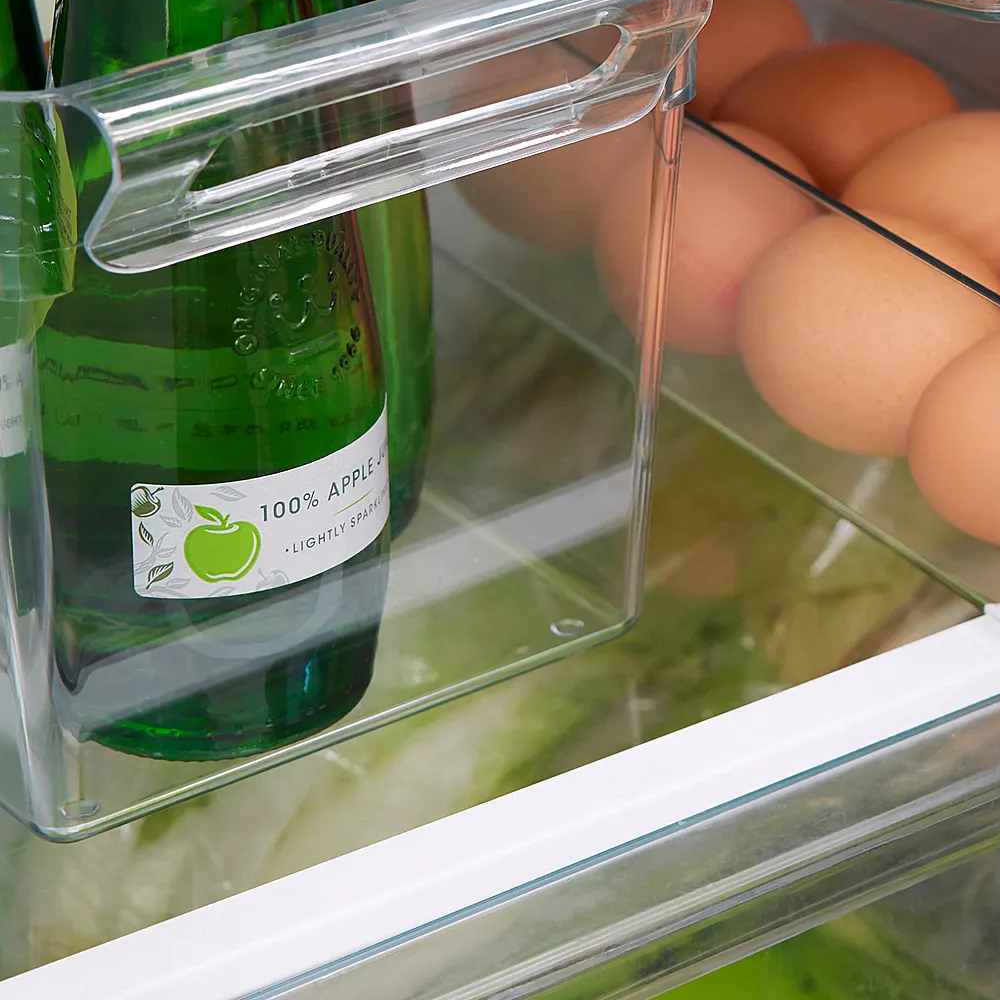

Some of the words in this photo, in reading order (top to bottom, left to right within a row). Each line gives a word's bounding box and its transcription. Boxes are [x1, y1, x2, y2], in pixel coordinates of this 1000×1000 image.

[260, 489, 320, 523] 100%
[327, 456, 374, 502] APPLE
[292, 522, 347, 554] LIGHTLY
[350, 481, 389, 528] SPARKLIN
